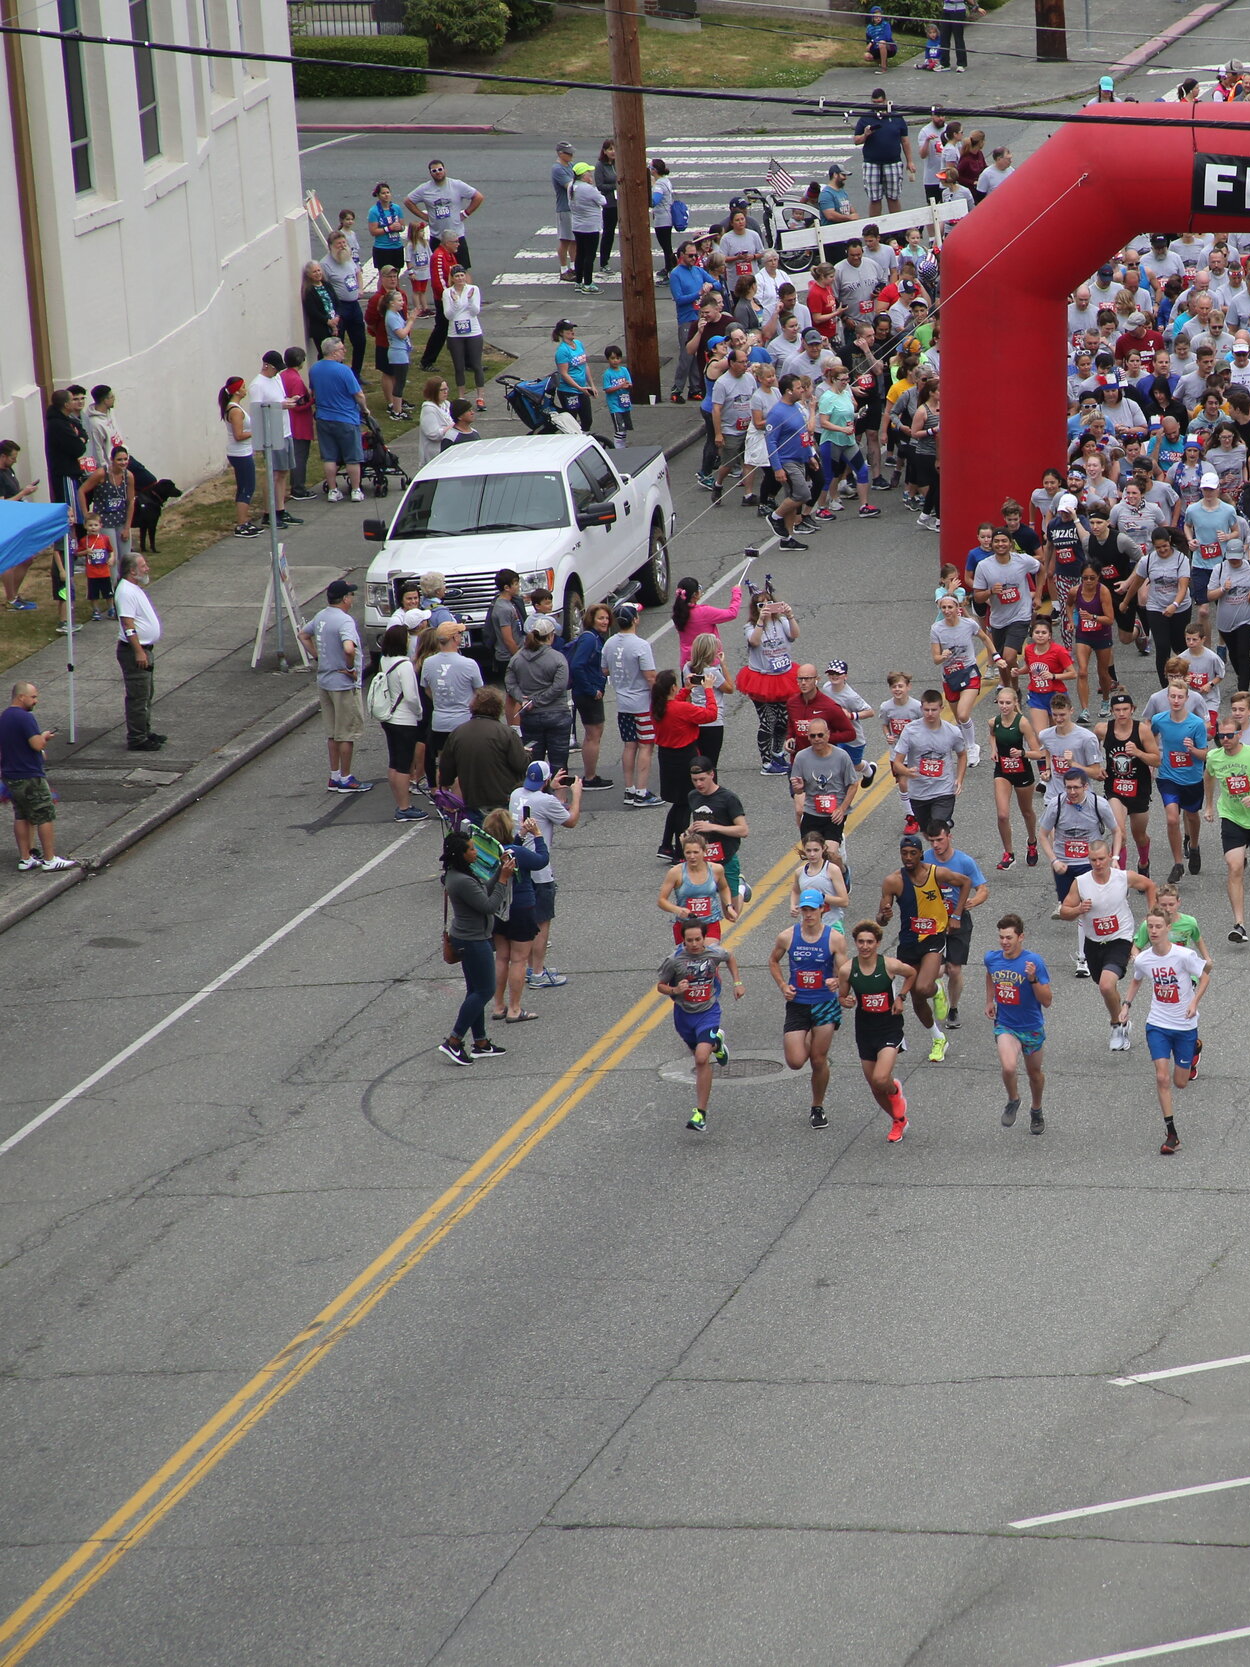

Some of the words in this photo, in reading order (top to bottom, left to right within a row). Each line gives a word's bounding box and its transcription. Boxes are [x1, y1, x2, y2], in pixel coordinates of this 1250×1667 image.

[773, 659, 791, 670] 1022
[1034, 680, 1049, 688] 391
[1192, 677, 1203, 685] 46
[1175, 754, 1187, 763] 85
[923, 764, 940, 772] 342
[1116, 784, 1134, 792] 489
[819, 799, 831, 808] 38
[1067, 846, 1085, 854] 442
[691, 903, 707, 912] 122
[914, 921, 933, 930] 482
[1098, 920, 1115, 930] 431
[1152, 967, 1177, 978] USA
[802, 976, 816, 984] 96
[1154, 976, 1179, 986] USA
[998, 990, 1015, 999] 474
[1157, 990, 1174, 999] 477
[866, 998, 885, 1008] 297
